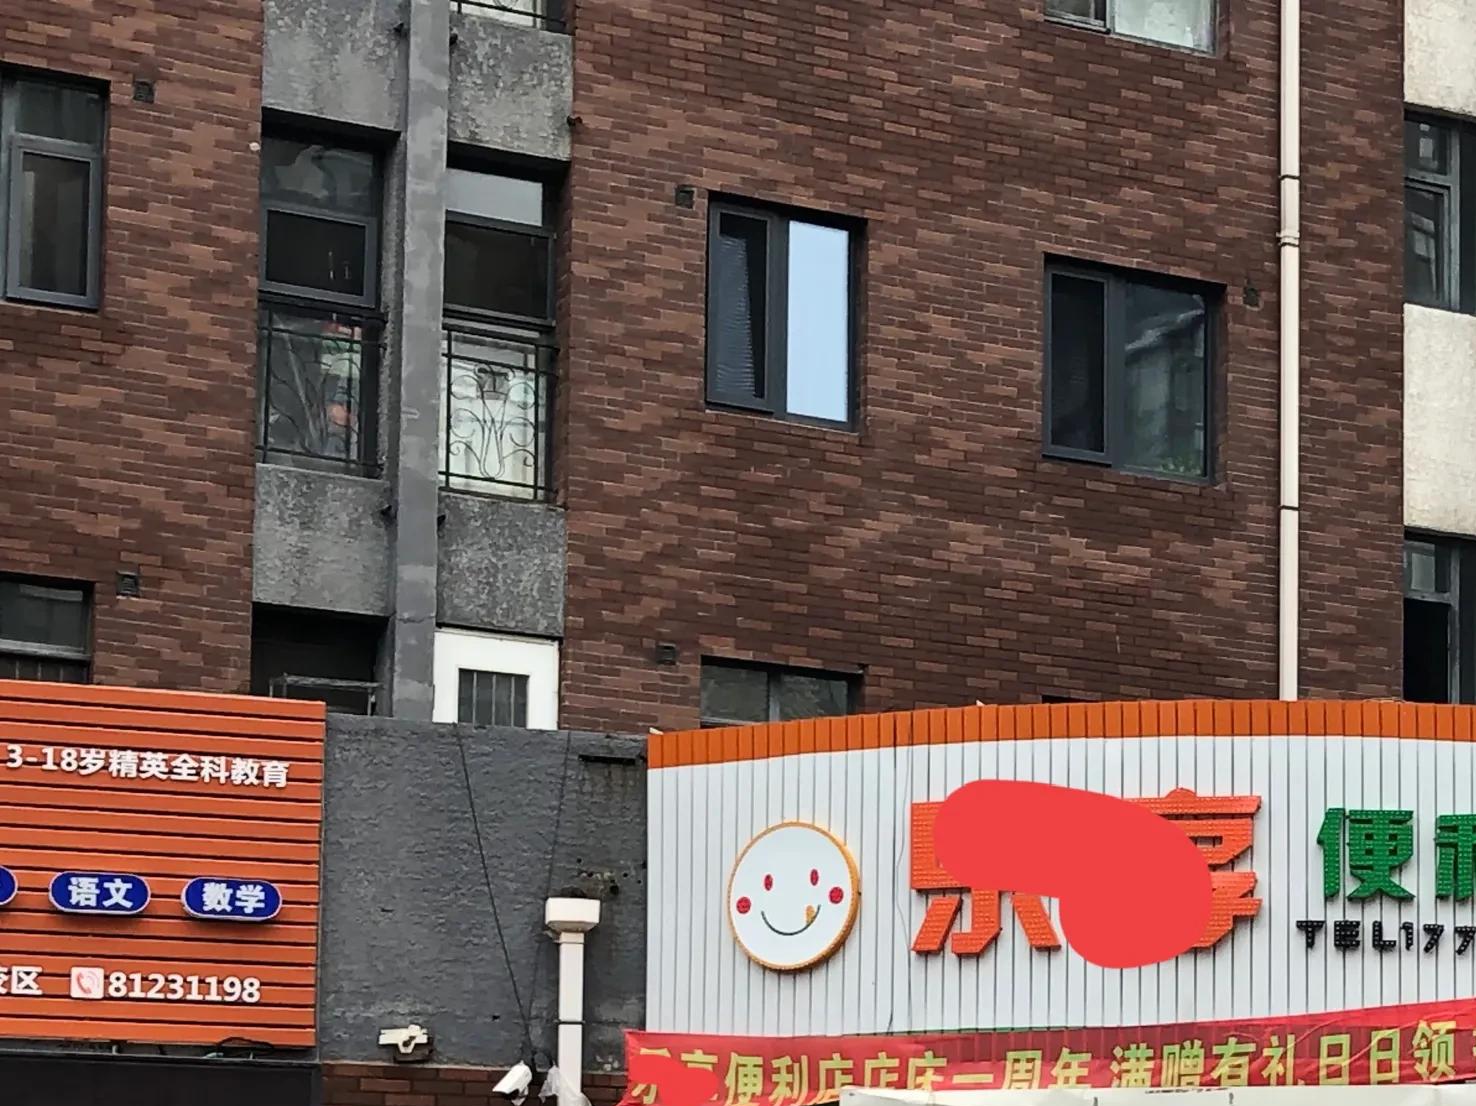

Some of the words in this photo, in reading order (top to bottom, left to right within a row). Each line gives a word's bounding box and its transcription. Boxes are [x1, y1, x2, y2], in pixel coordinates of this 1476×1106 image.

[6, 744, 290, 789] 3-18岁精英全科教育
[68, 876, 134, 909] 语文
[201, 882, 266, 913] 数学
[108, 971, 261, 1003] 81231198
